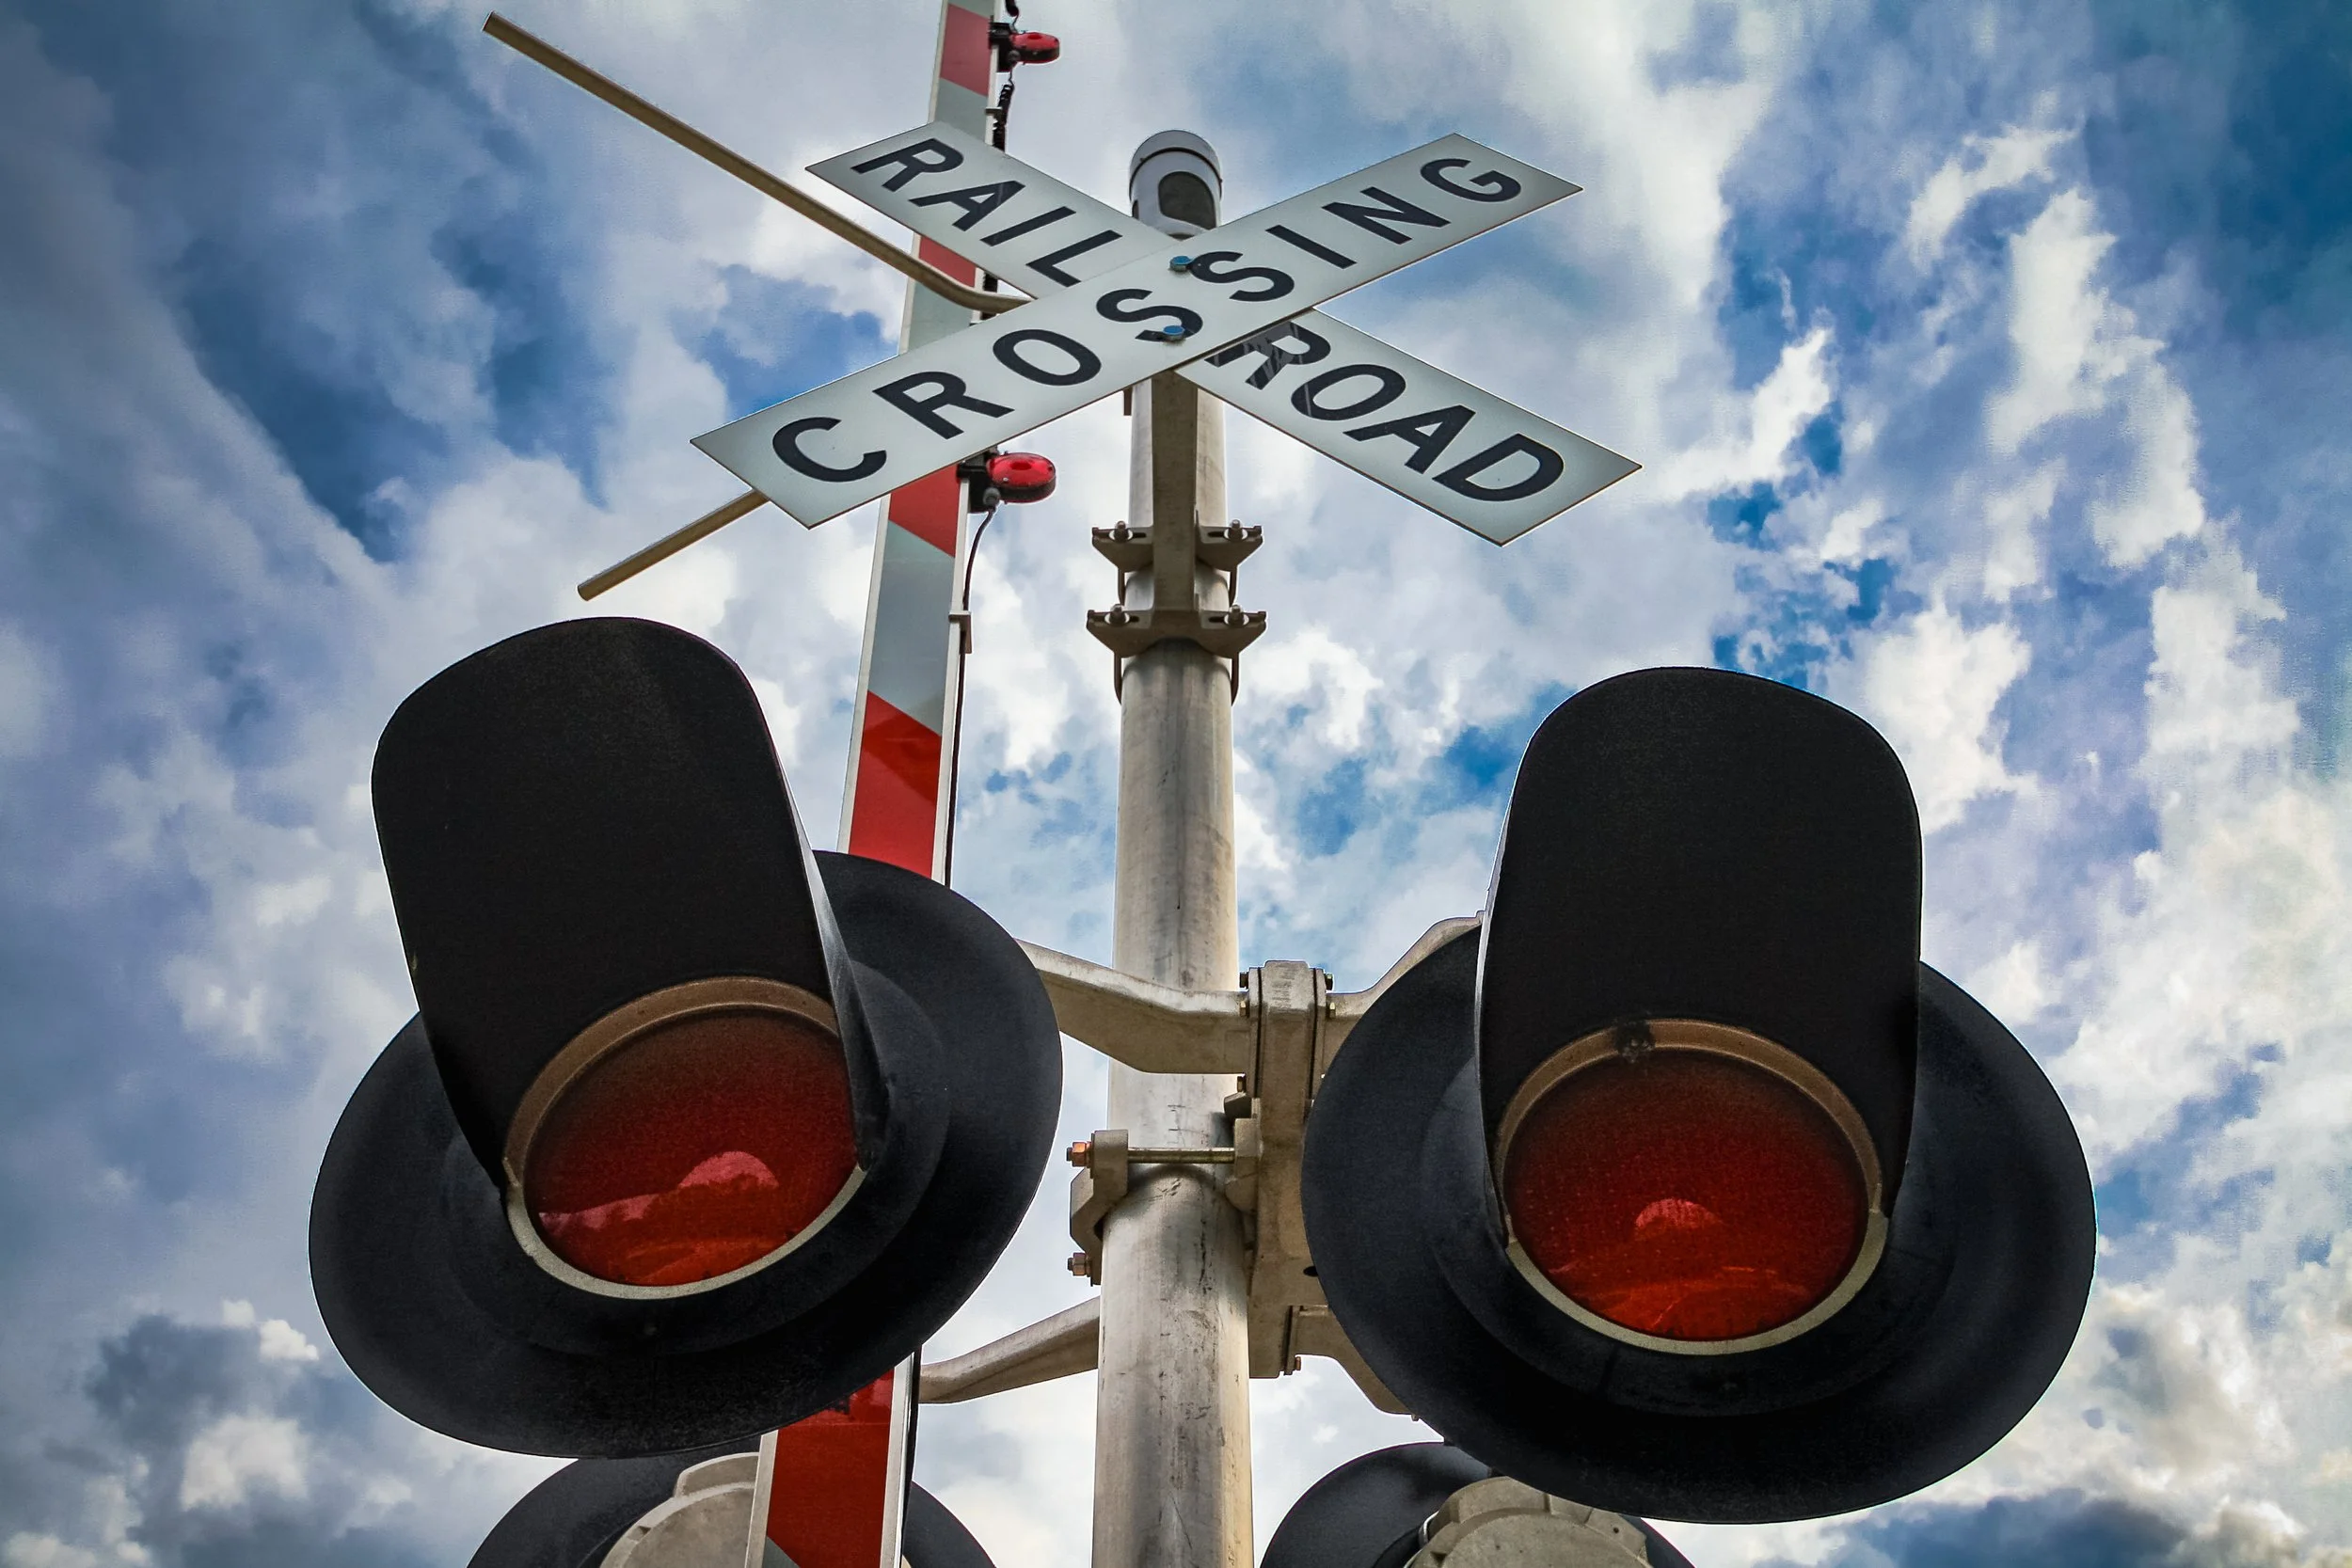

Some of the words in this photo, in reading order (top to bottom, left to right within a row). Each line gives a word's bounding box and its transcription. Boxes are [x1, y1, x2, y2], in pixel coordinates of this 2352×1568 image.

[771, 158, 1522, 483] CROSSING
[851, 137, 1123, 288] RAIL
[1203, 320, 1565, 502] ROAD
